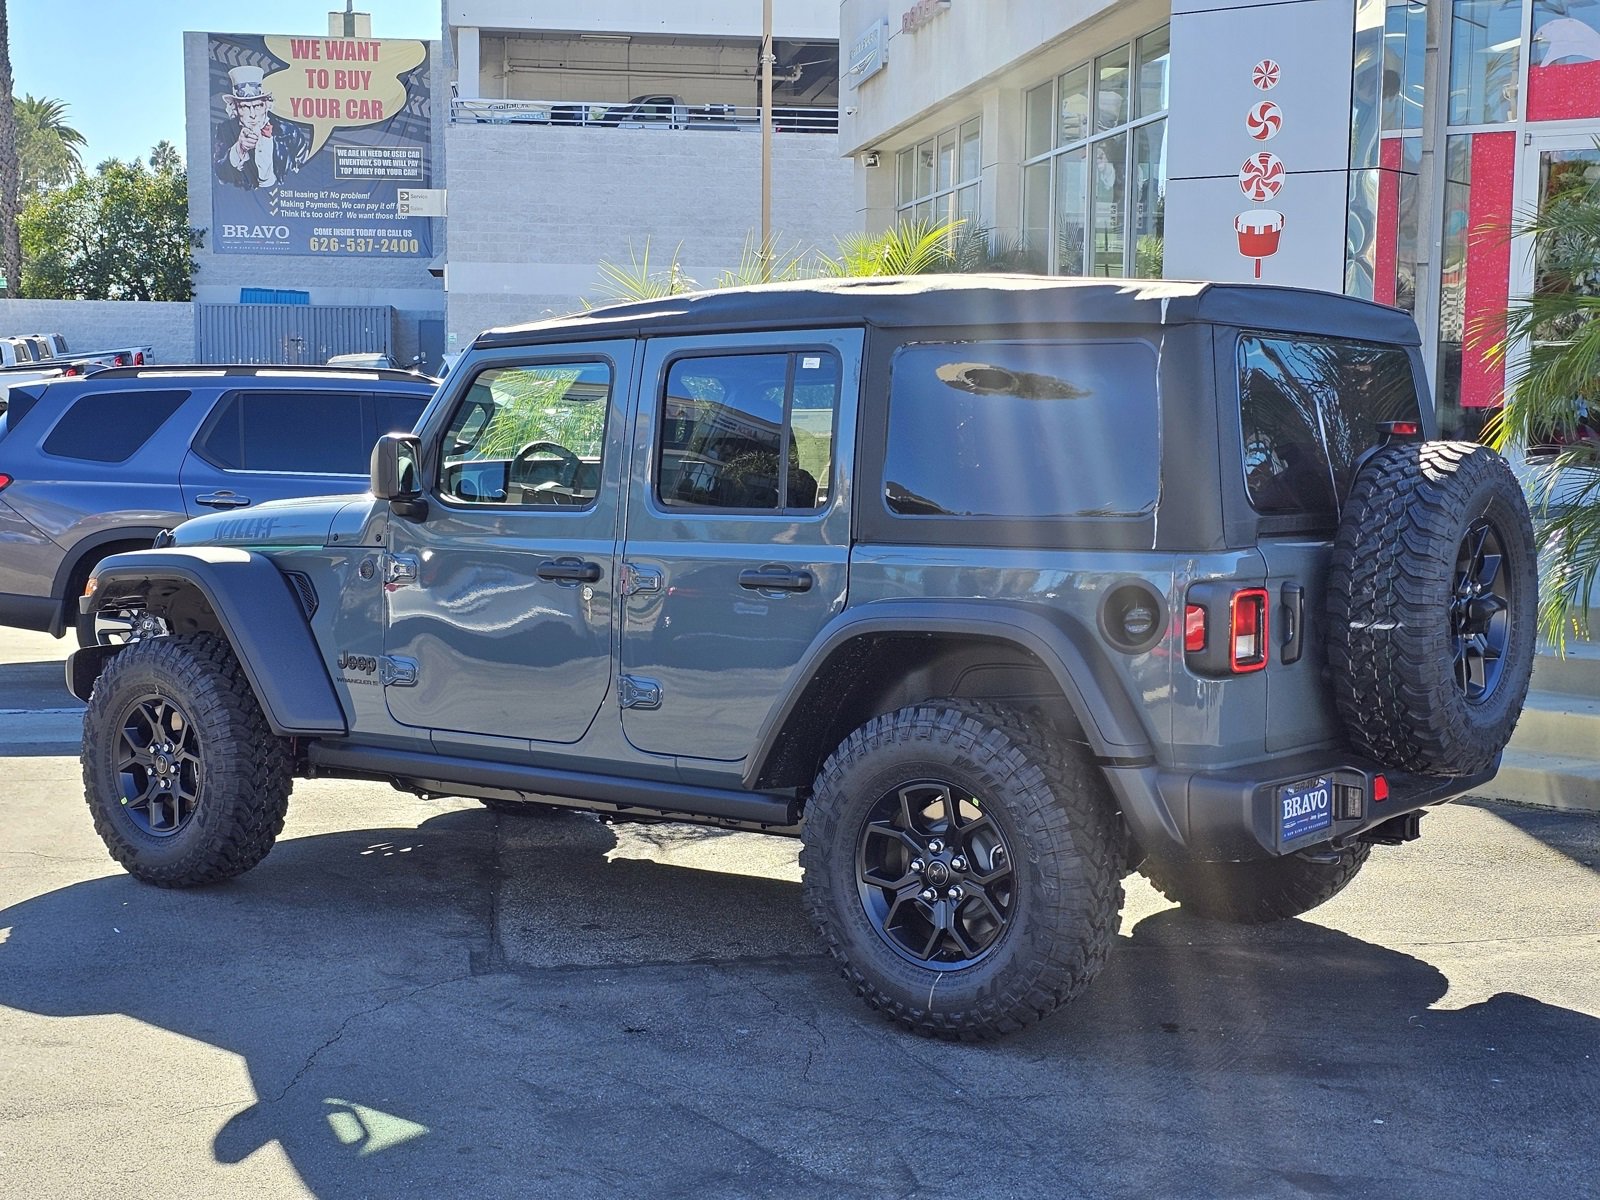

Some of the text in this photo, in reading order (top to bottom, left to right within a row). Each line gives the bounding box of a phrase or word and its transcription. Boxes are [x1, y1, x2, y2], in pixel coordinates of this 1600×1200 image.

[290, 39, 381, 62] WE WANT
[305, 68, 371, 91] TO BUY
[290, 97, 383, 120] YOUR CAR
[337, 149, 347, 157] WE
[367, 150, 382, 158] NEED
[383, 150, 390, 158] OF
[339, 158, 373, 167] INVENTORY,
[373, 159, 381, 167] SO
[382, 159, 392, 167] WE
[340, 167, 352, 175] TOP
[386, 168, 402, 176] YOUR
[403, 168, 418, 176] CAR!
[280, 190, 370, 201] Still leasing it? No problem!
[280, 200, 304, 209] Making
[305, 200, 340, 210] Payments,
[366, 203, 379, 211] pay
[380, 202, 385, 210] it
[386, 202, 395, 210] off
[280, 210, 299, 218] Think
[300, 210, 311, 218] it's
[311, 210, 323, 218] too
[375, 212, 394, 220] those
[222, 224, 290, 239] BRAVO
[313, 227, 412, 237] COME INSIDE TODAY OR CALL US
[309, 236, 419, 254] 626-537-2400
[337, 650, 377, 675] Jeep
[336, 677, 372, 686] WRANGLER
[1283, 789, 1328, 820] BRAVO
